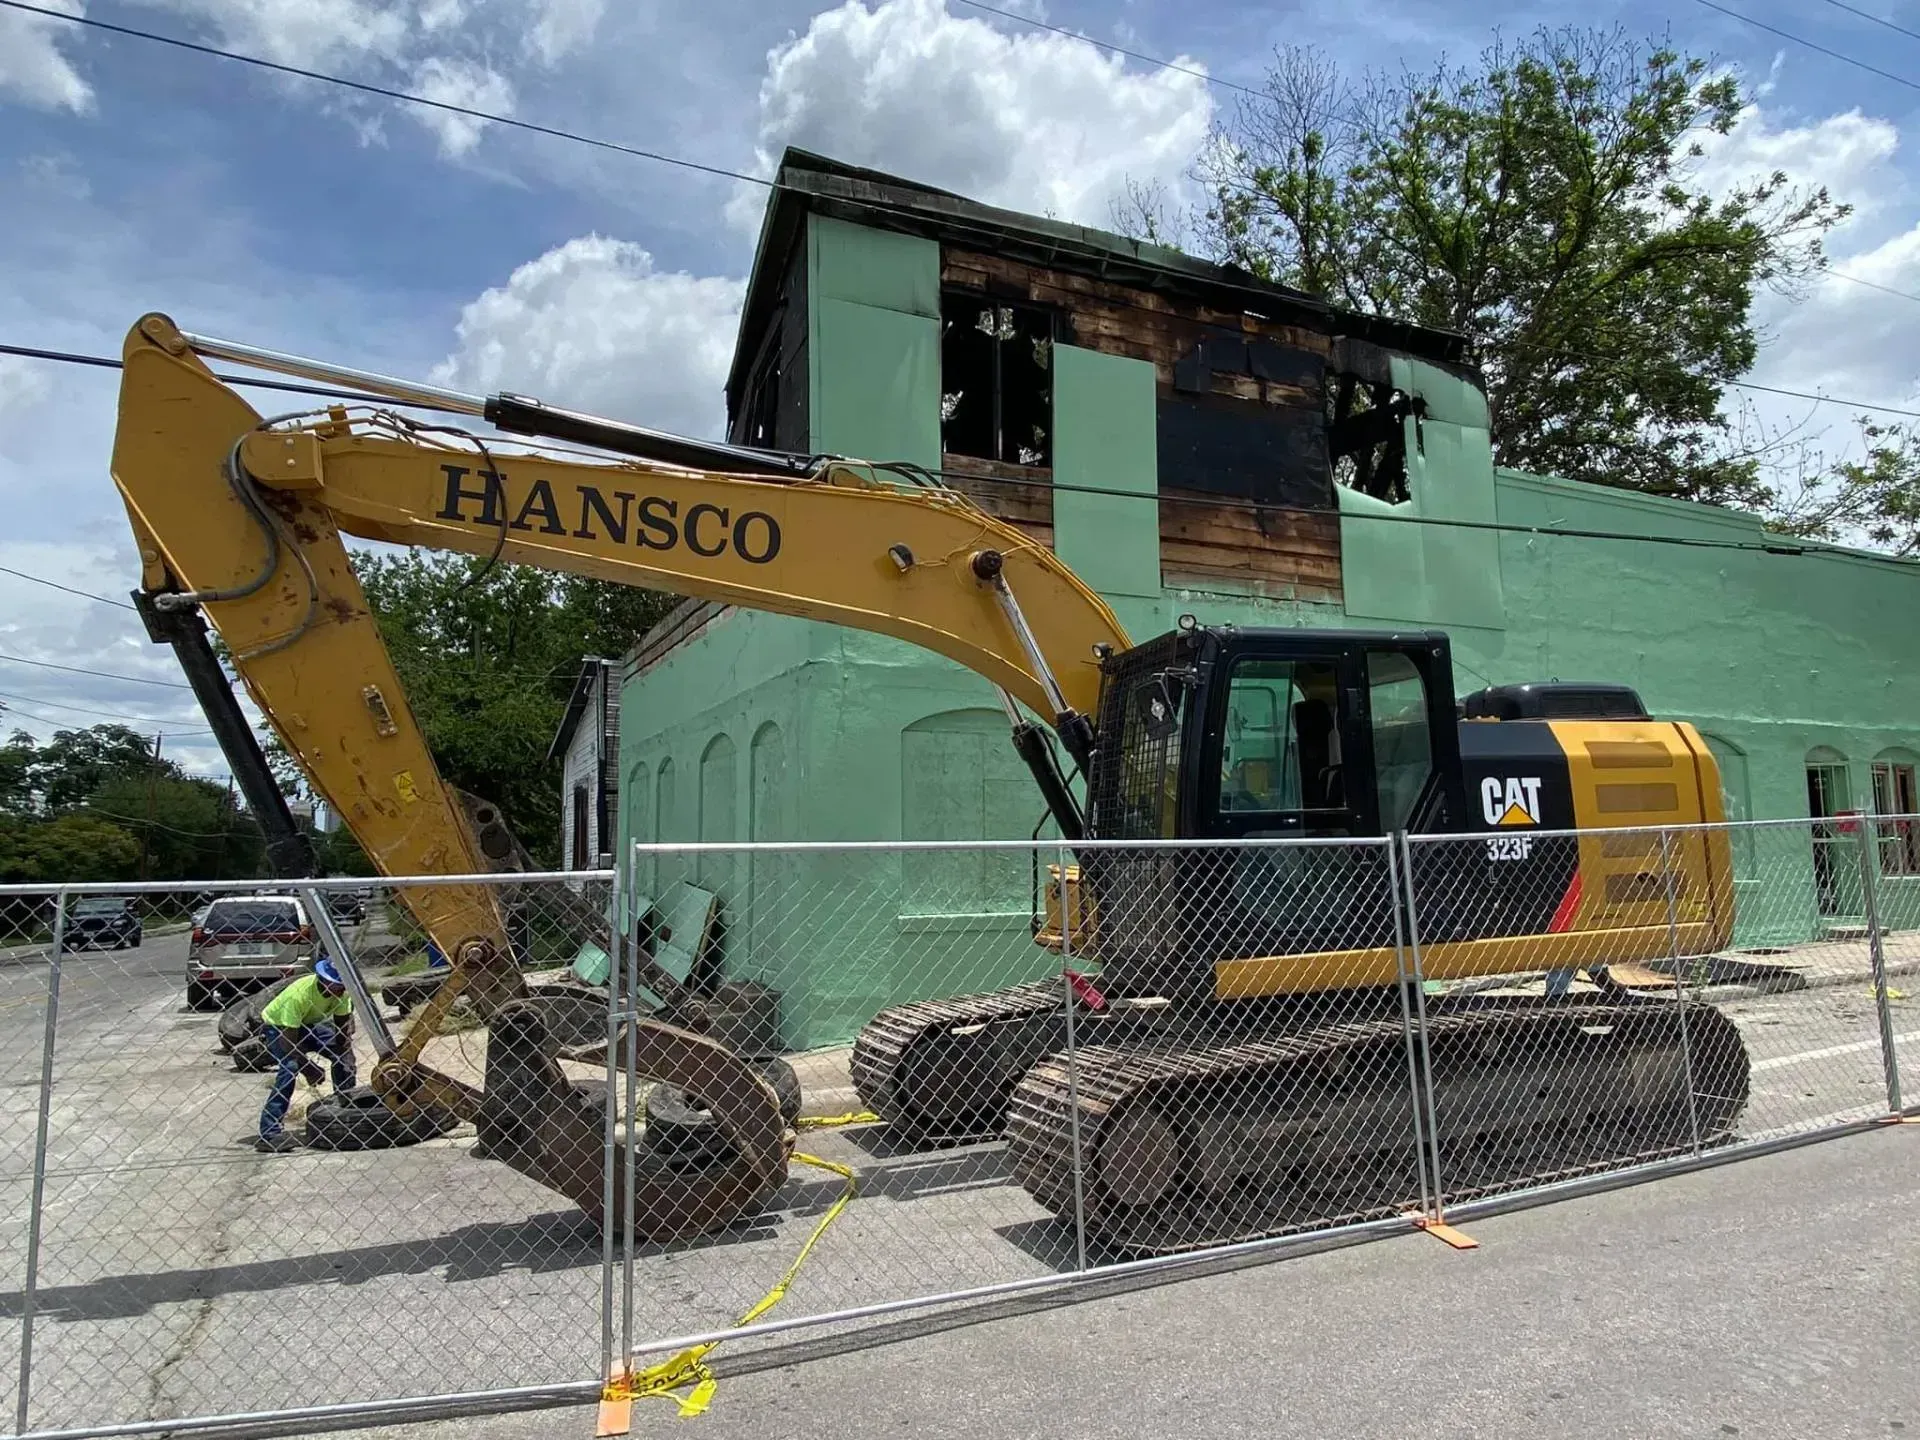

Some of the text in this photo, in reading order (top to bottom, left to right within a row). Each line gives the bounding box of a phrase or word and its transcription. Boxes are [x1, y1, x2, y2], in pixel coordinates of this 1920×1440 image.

[435, 463, 782, 564] HANSCO
[1481, 777, 1542, 825] CAT
[1486, 837, 1532, 861] 323F
